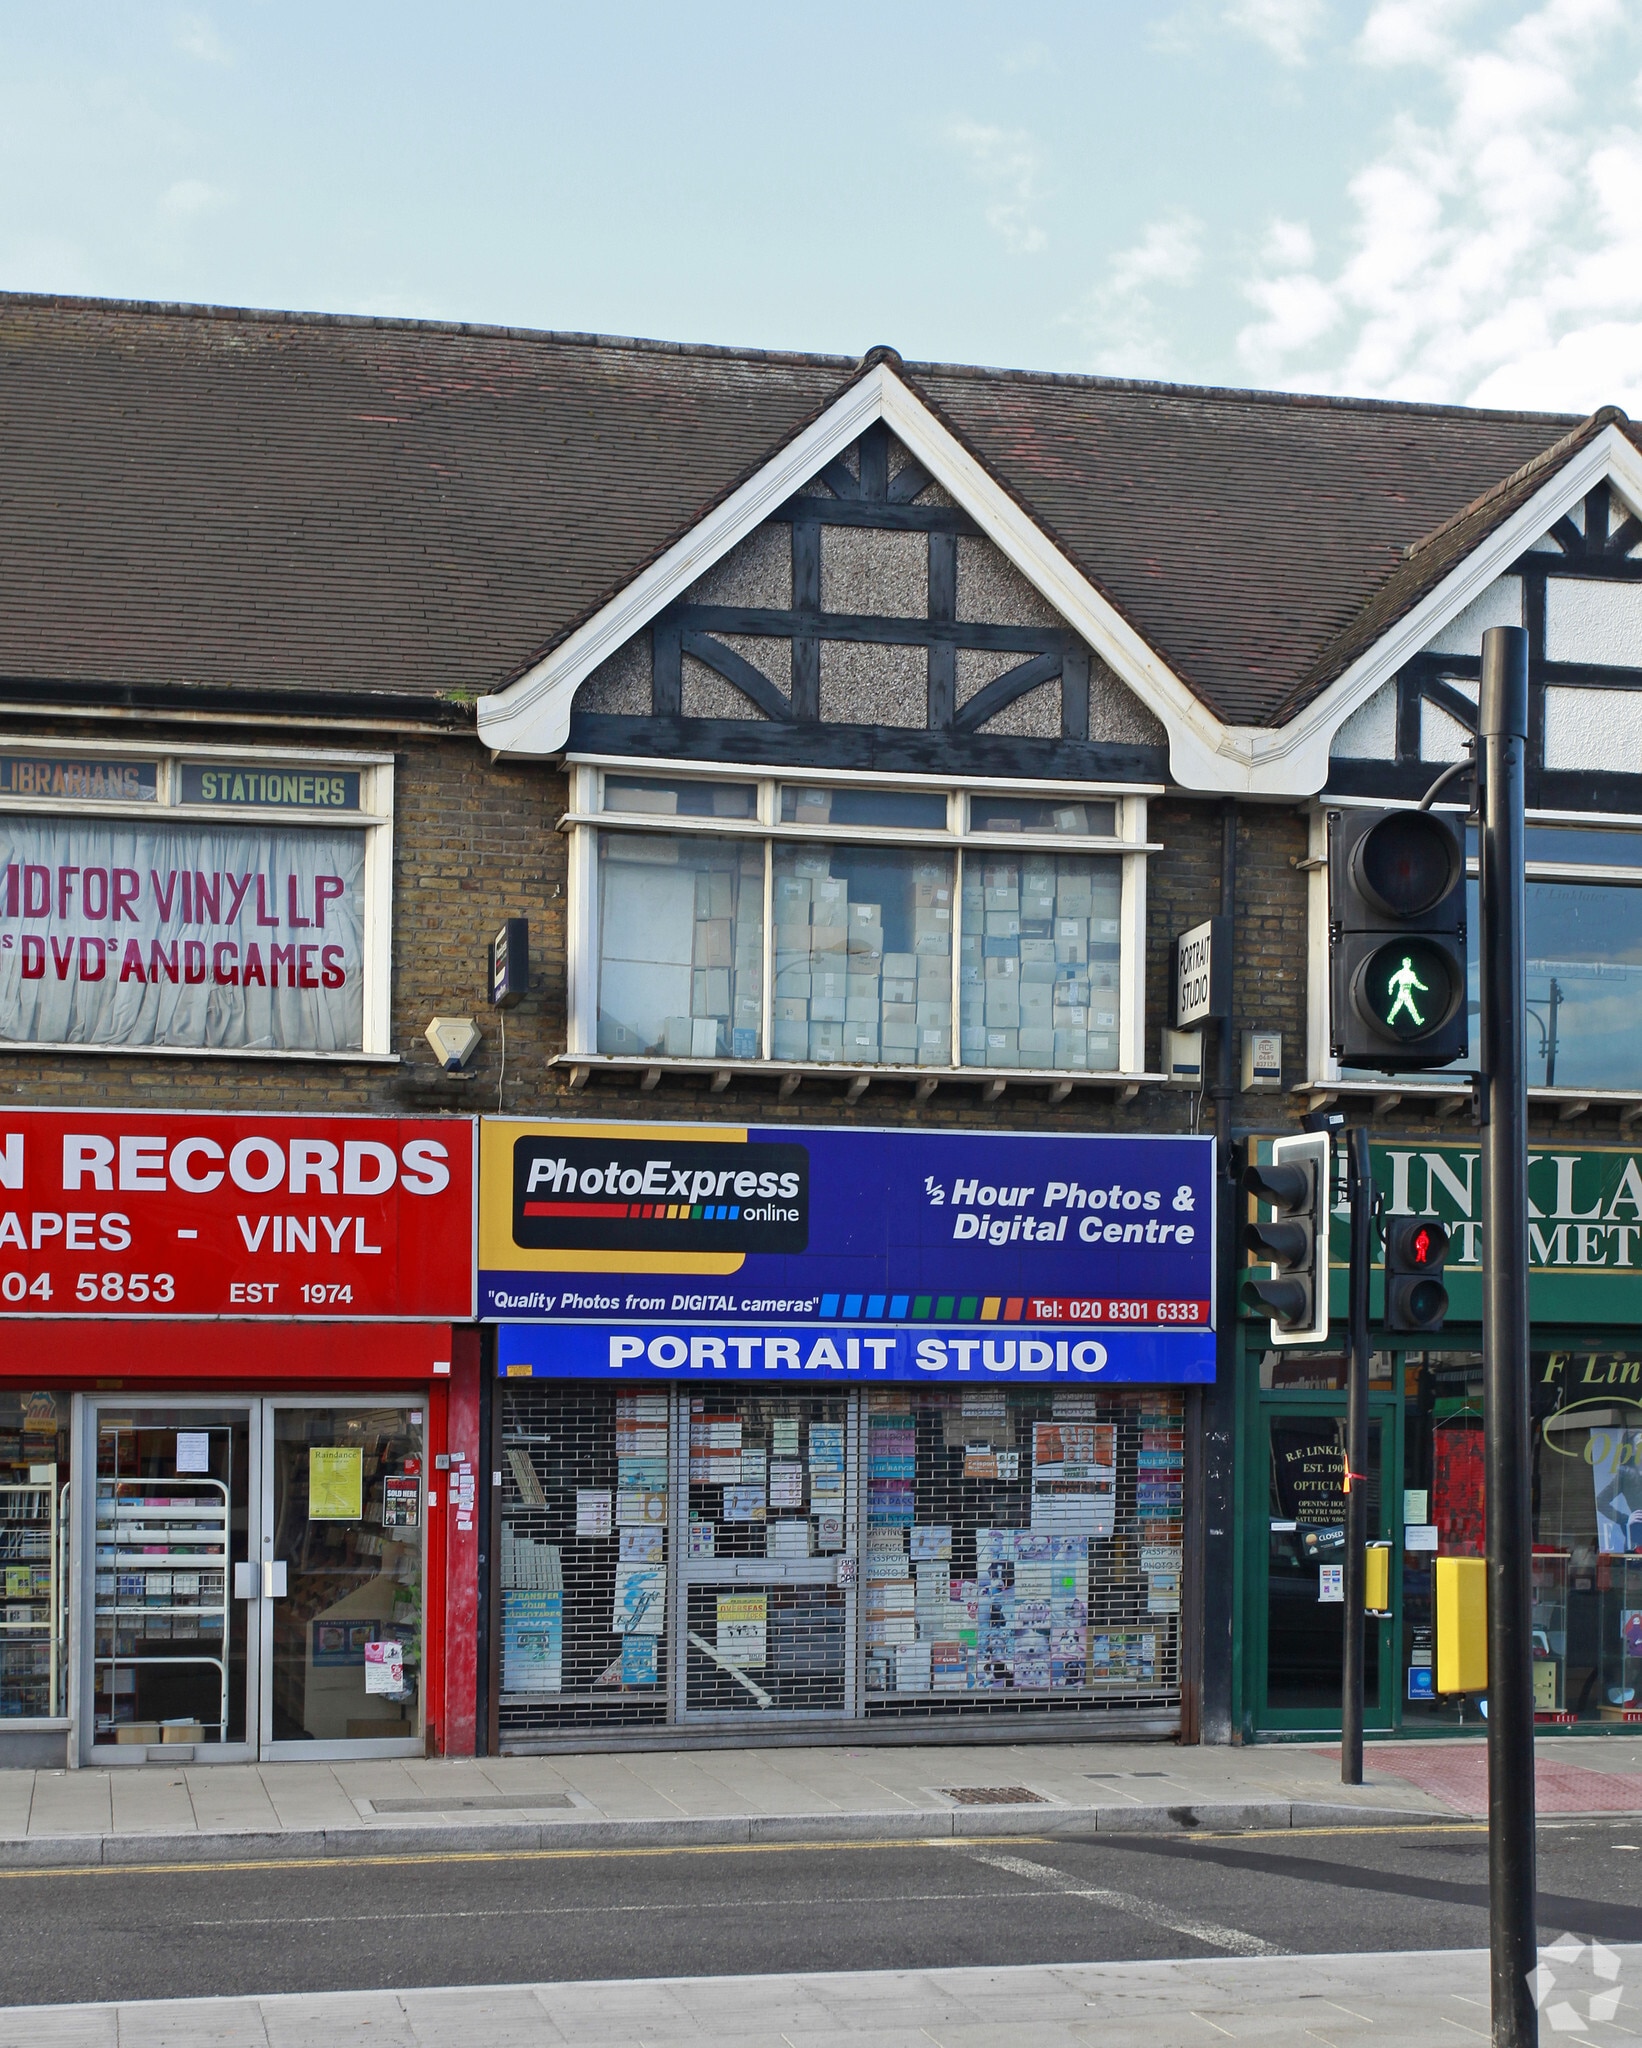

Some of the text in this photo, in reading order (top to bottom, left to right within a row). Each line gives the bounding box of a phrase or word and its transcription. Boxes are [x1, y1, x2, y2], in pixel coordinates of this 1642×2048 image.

[202, 771, 346, 805] STATIONERS
[0, 864, 51, 918] ID
[58, 866, 140, 922] FOR
[151, 869, 280, 926] VINYL
[119, 938, 206, 985] AND
[213, 941, 346, 989] GAMES
[1179, 935, 1211, 977] PORTRAIT
[1182, 973, 1208, 1012] STUDIO
[1258, 1043, 1274, 1051] ACE
[63, 1134, 451, 1196] RECORDS
[526, 1158, 800, 1204] PhotoExpress
[951, 1178, 1035, 1207] Hour
[1043, 1181, 1162, 1211] Photos
[1172, 1185, 1196, 1212] &
[1331, 1150, 1642, 1221] INLA
[743, 1203, 800, 1222] online
[0, 1212, 132, 1252] APES
[237, 1216, 382, 1254] VINYL
[953, 1213, 1195, 1246] Digital Centre
[1380, 1222, 1641, 1266] TMET
[1, 1271, 354, 1304] 04 5853 EST 1974
[488, 1289, 819, 1313] "Quality Photos from DIGITAL cameras"
[1033, 1301, 1199, 1320] Tel: 020 8301 6333
[609, 1335, 1108, 1373] PORTRAIT STUDIO
[1540, 1353, 1571, 1383] F
[315, 1450, 357, 1459] Raindance
[1285, 1449, 1305, 1462] R.F.
[1303, 1463, 1346, 1473] EST. 190
[387, 1490, 417, 1498] SOLD HERE
[1293, 1480, 1342, 1491] OPTICIA
[1318, 1530, 1344, 1542] CLOSED
